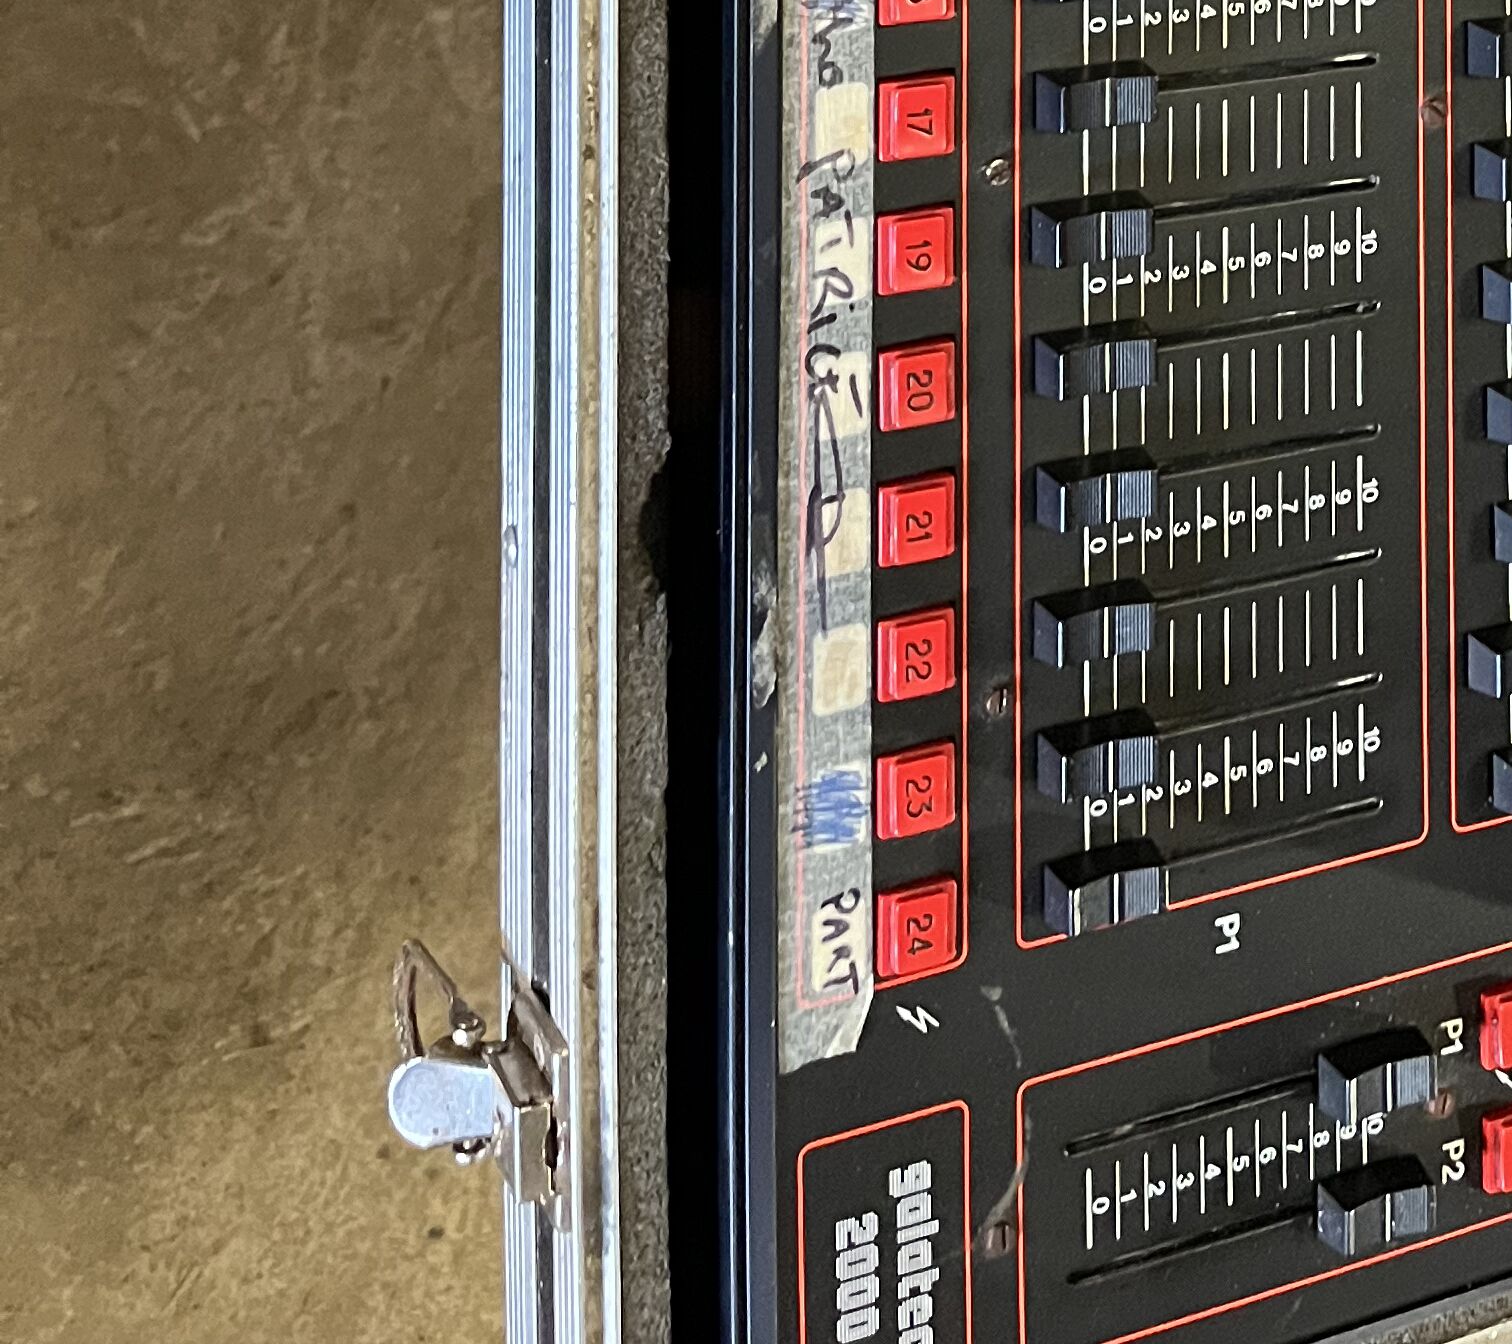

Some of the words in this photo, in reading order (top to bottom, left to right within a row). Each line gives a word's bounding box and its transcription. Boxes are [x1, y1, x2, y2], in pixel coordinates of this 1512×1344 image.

[906, 107, 934, 136] 17
[905, 239, 933, 272] 19
[906, 369, 934, 413] 20
[905, 510, 933, 543] 21
[904, 638, 933, 684] 22
[1336, 738, 1354, 757] 9
[1363, 725, 1381, 753] 10
[1283, 751, 1300, 767] 7
[1309, 744, 1328, 763] 8
[1229, 764, 1248, 782] 5
[1255, 757, 1274, 776] 6
[1173, 778, 1192, 797] 3
[1201, 771, 1220, 789] 4
[905, 774, 933, 819] 23
[1145, 785, 1164, 804] 2
[1089, 798, 1108, 818] 0
[819, 888, 861, 996] PART
[906, 913, 934, 956] 24
[1213, 912, 1242, 956] P1
[1440, 1016, 1464, 1057] P1
[1339, 1123, 1358, 1141] 9
[1366, 1111, 1384, 1136] 10
[1285, 1138, 1304, 1154] 7
[1312, 1129, 1331, 1149] 8
[1231, 1154, 1251, 1173] 5
[1258, 1146, 1278, 1165] 6
[1440, 1136, 1466, 1187] P2
[1175, 1171, 1195, 1191] 3
[1203, 1163, 1222, 1181] 4
[1147, 1179, 1166, 1199] 2
[1091, 1196, 1111, 1215] 0
[834, 1210, 881, 1344] 2000
